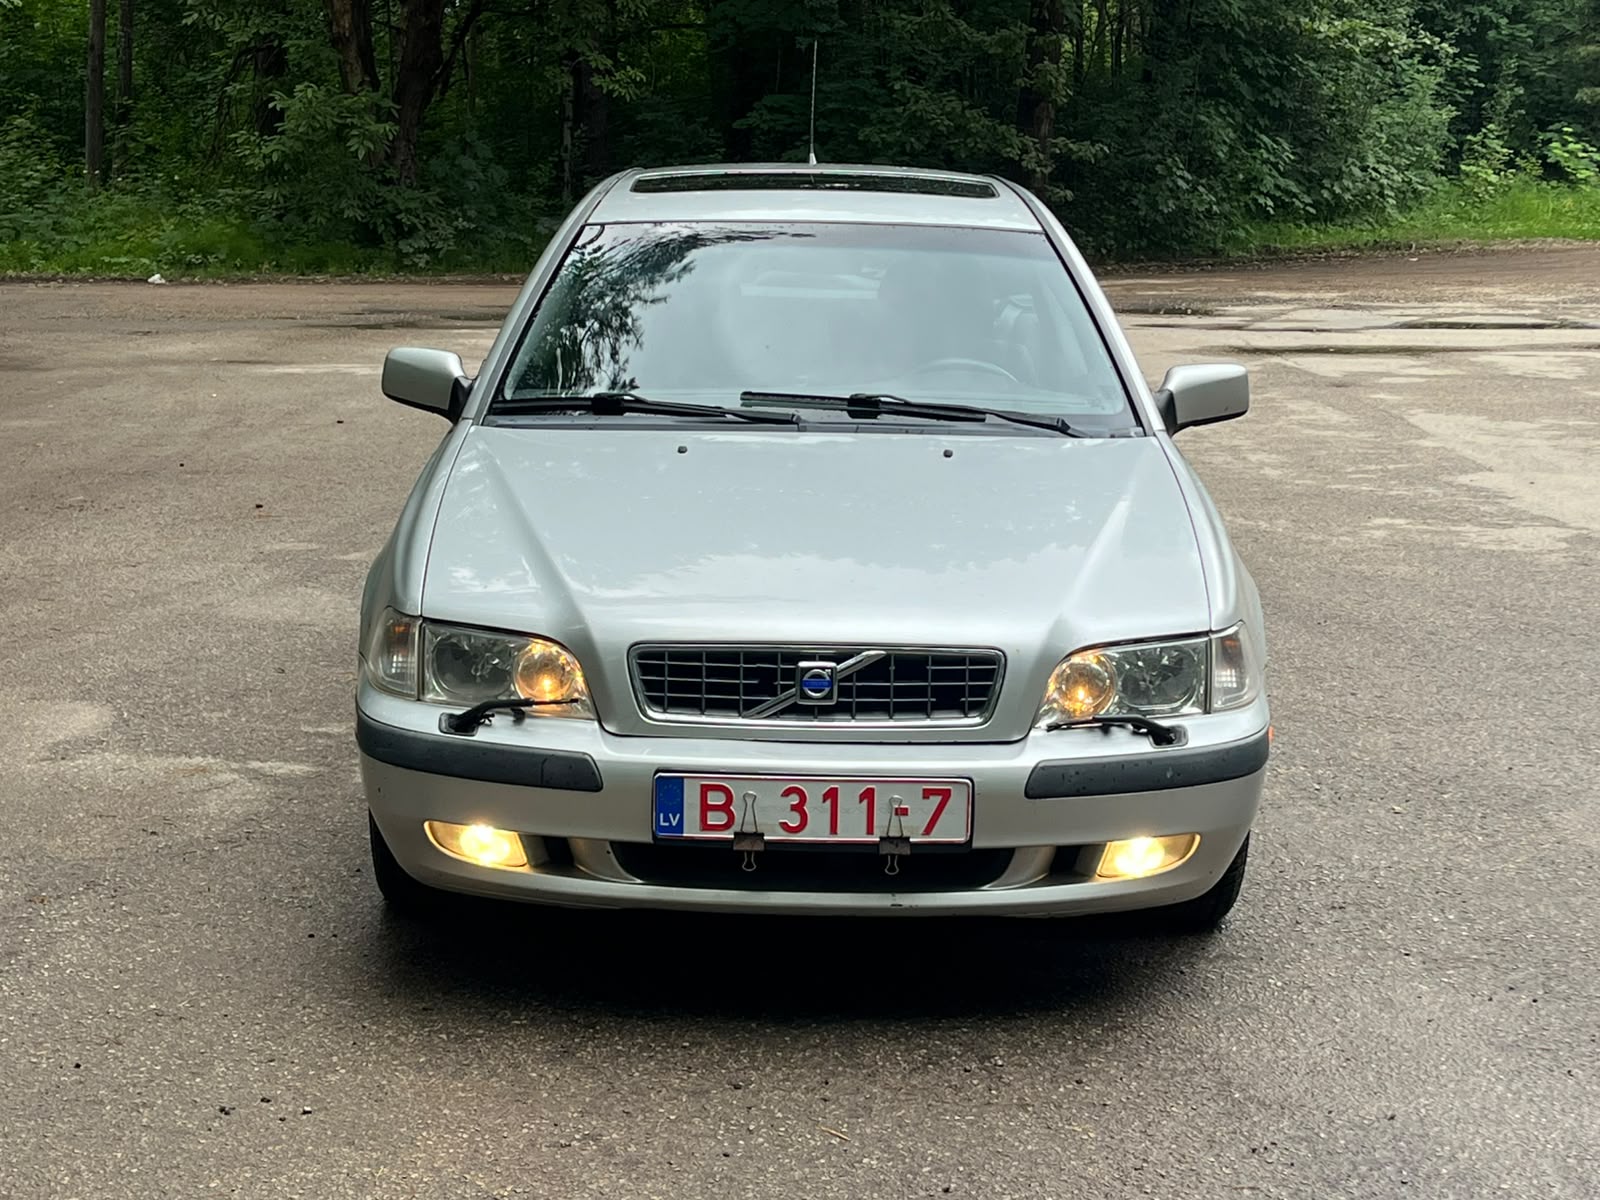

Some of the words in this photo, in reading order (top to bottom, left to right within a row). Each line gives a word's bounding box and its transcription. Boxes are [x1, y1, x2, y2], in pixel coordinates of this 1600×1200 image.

[659, 813, 680, 827] LV
[699, 782, 736, 832] B
[778, 784, 952, 836] 311-7
